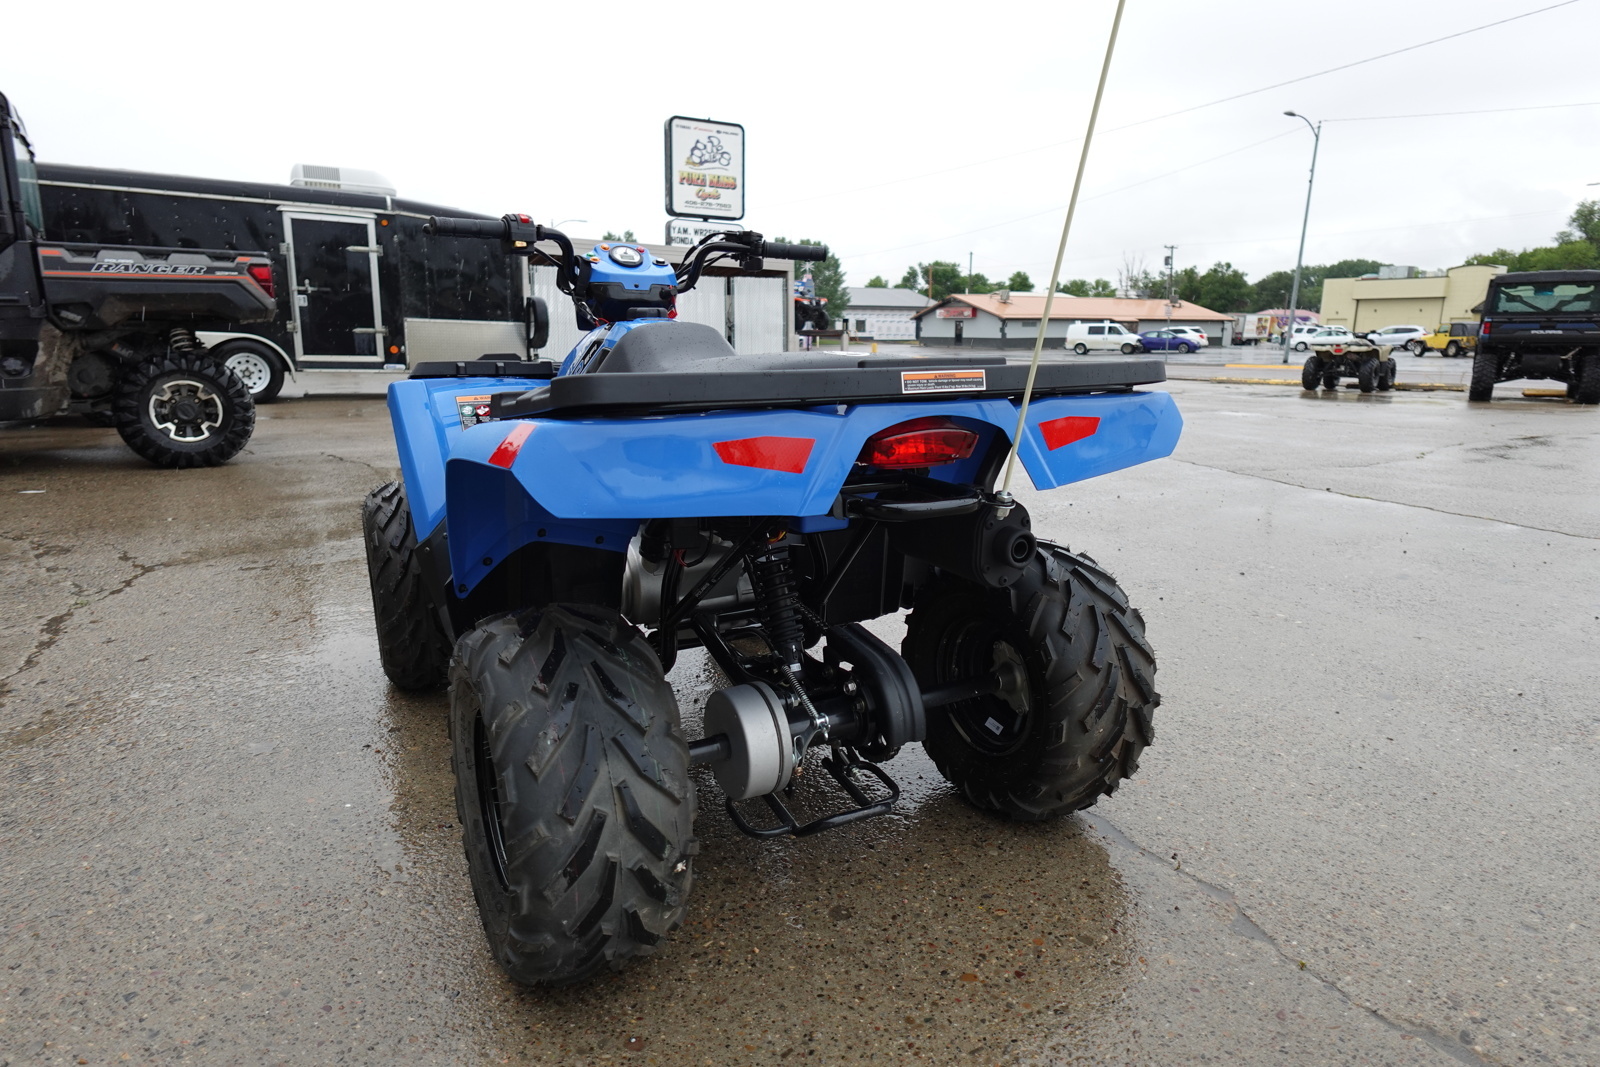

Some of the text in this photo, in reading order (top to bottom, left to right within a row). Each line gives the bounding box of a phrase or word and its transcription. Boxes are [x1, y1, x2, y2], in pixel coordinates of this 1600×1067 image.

[679, 172, 706, 186] PURE
[696, 187, 721, 201] Cycle
[672, 226, 692, 236] YAM.
[672, 236, 694, 245] HONDA
[91, 262, 207, 275] RANGER
